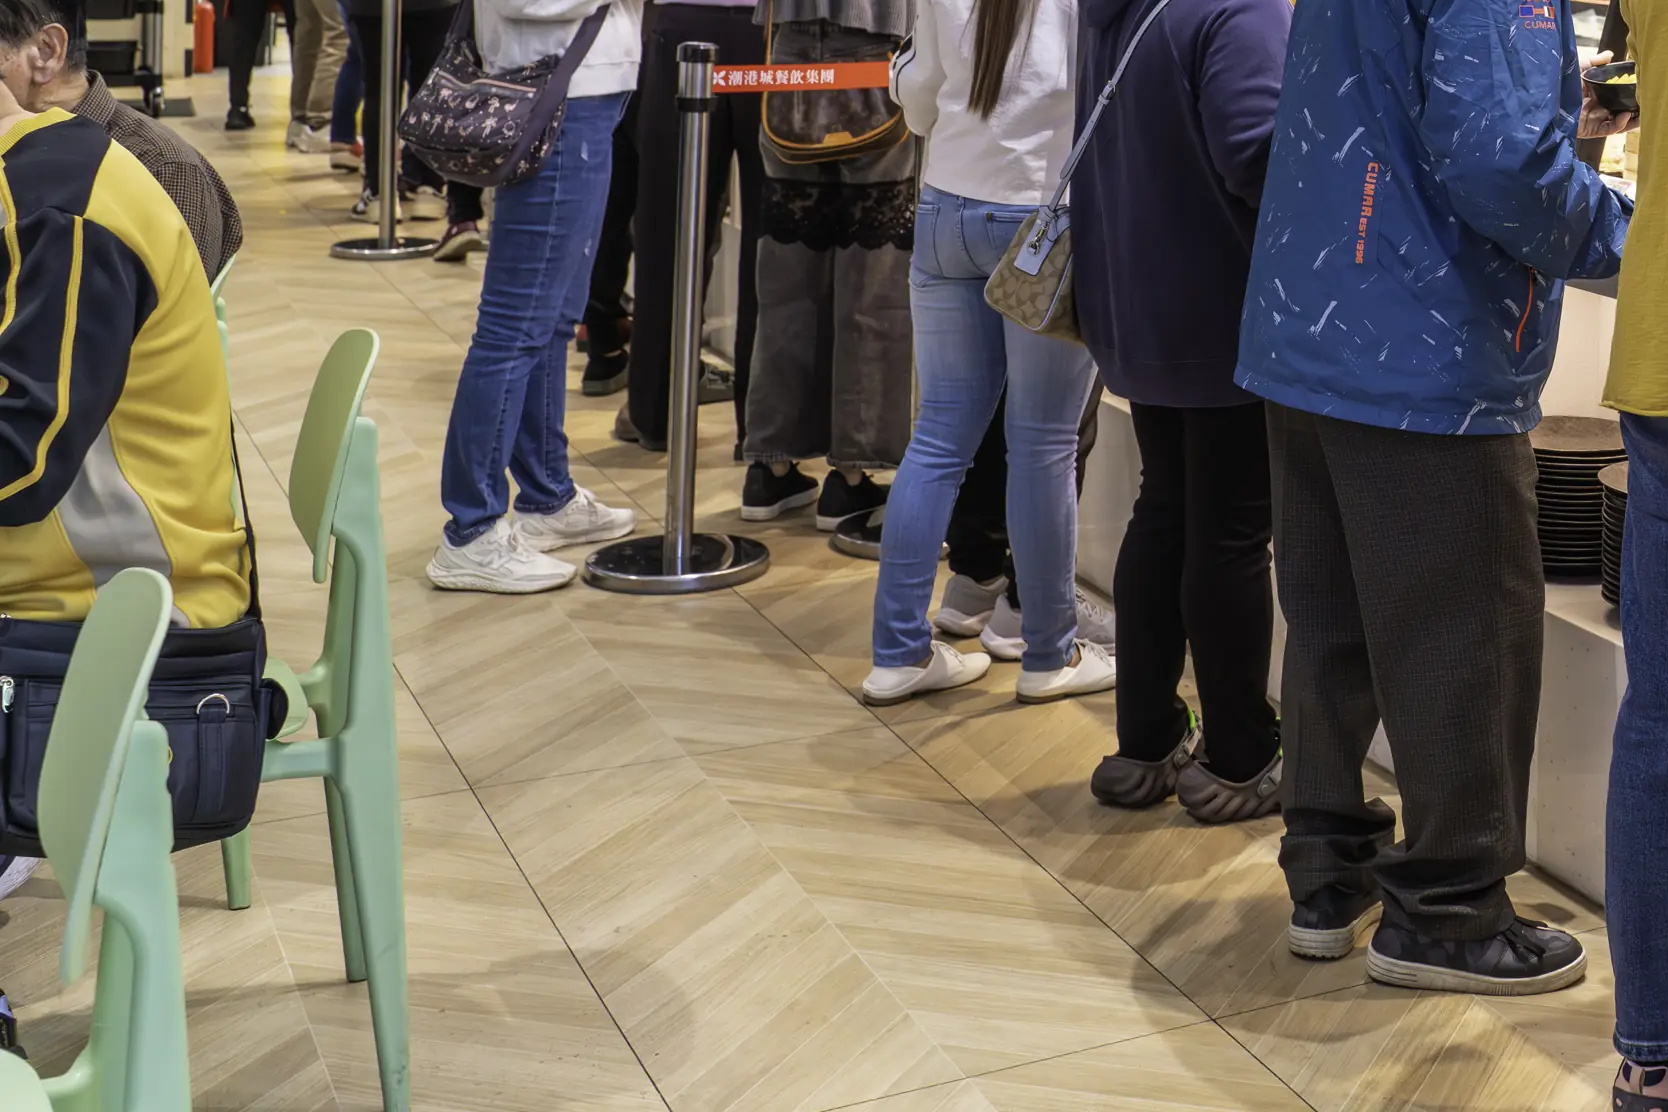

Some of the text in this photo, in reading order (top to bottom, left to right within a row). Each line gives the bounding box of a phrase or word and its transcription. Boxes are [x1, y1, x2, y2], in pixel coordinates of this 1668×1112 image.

[728, 69, 835, 86] 潮港城餐飲集團
[1361, 162, 1379, 217] CUMAR
